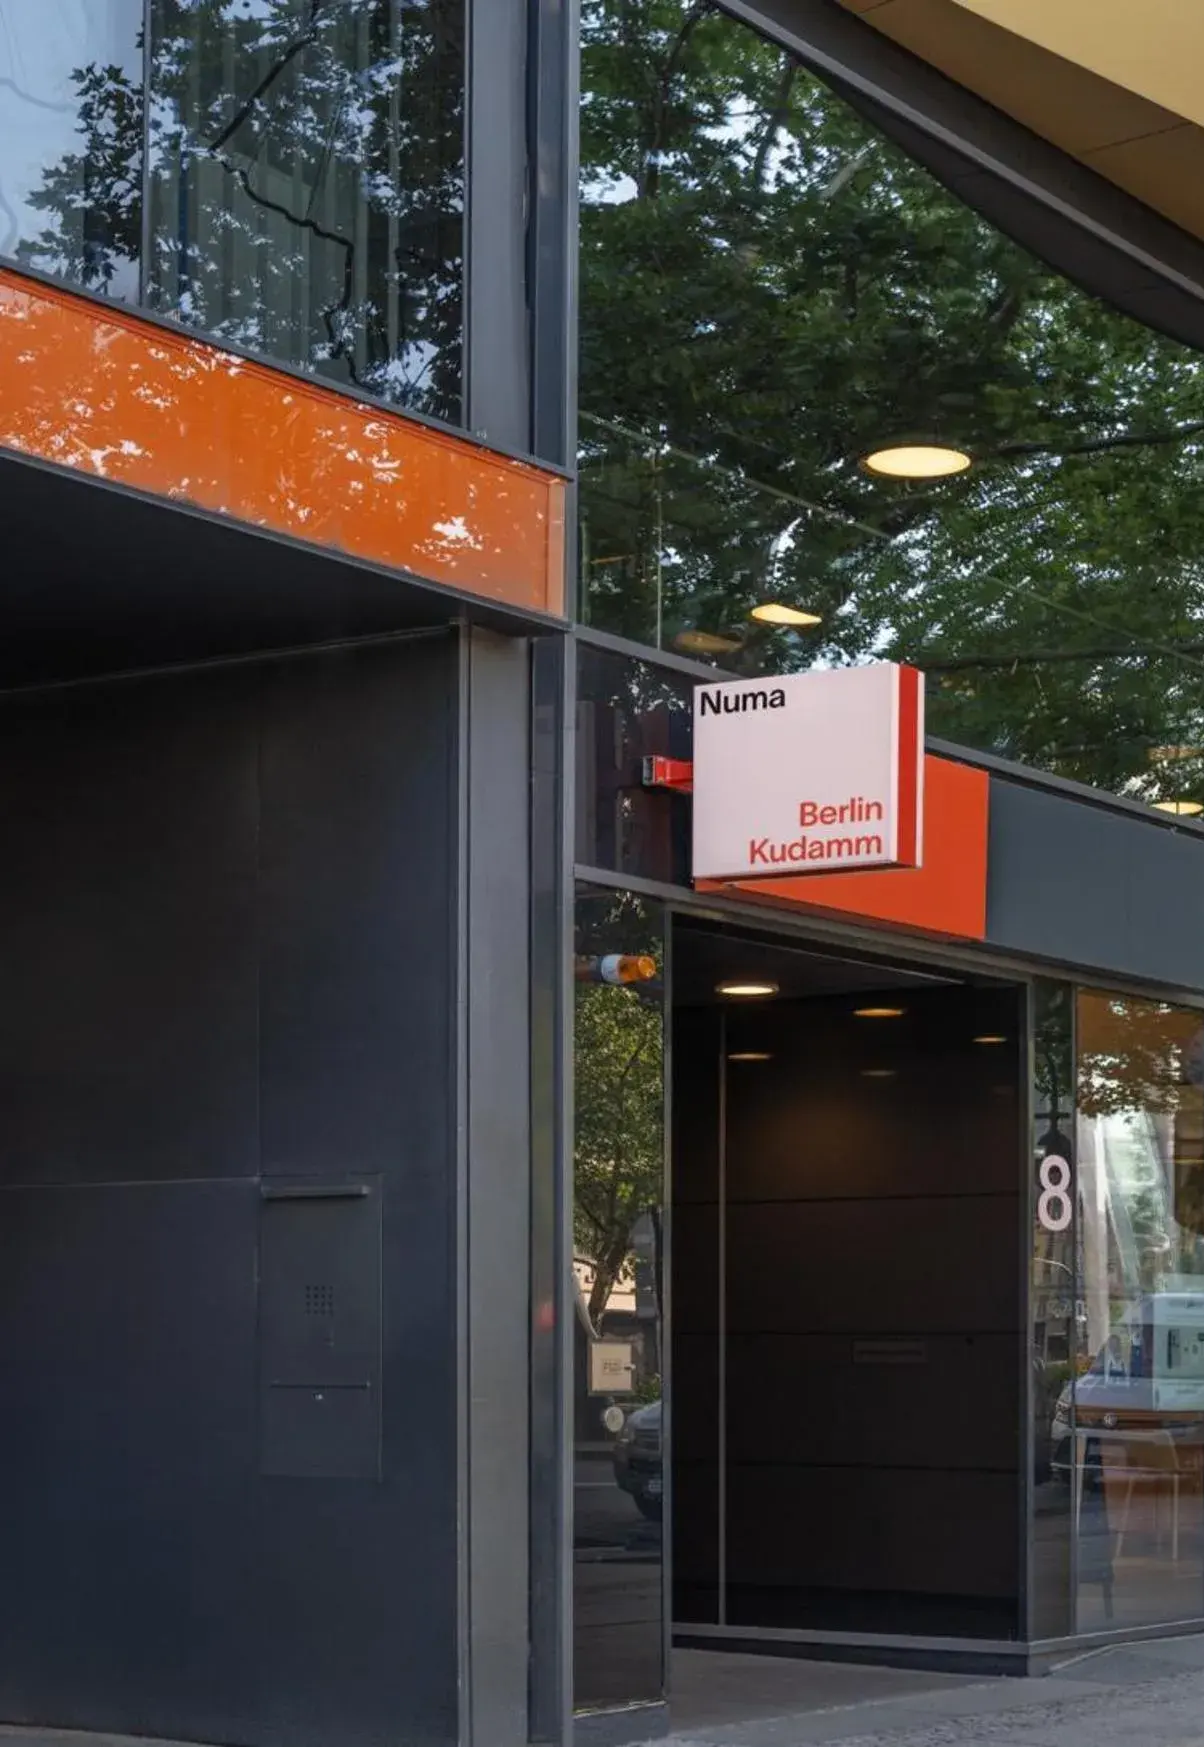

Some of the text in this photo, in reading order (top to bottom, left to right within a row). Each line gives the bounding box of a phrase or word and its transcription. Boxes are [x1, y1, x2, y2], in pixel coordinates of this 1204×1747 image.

[700, 688, 786, 717] Numa
[800, 797, 882, 827] Berlin
[749, 834, 882, 865] Kudamm
[1038, 1154, 1073, 1231] 8
